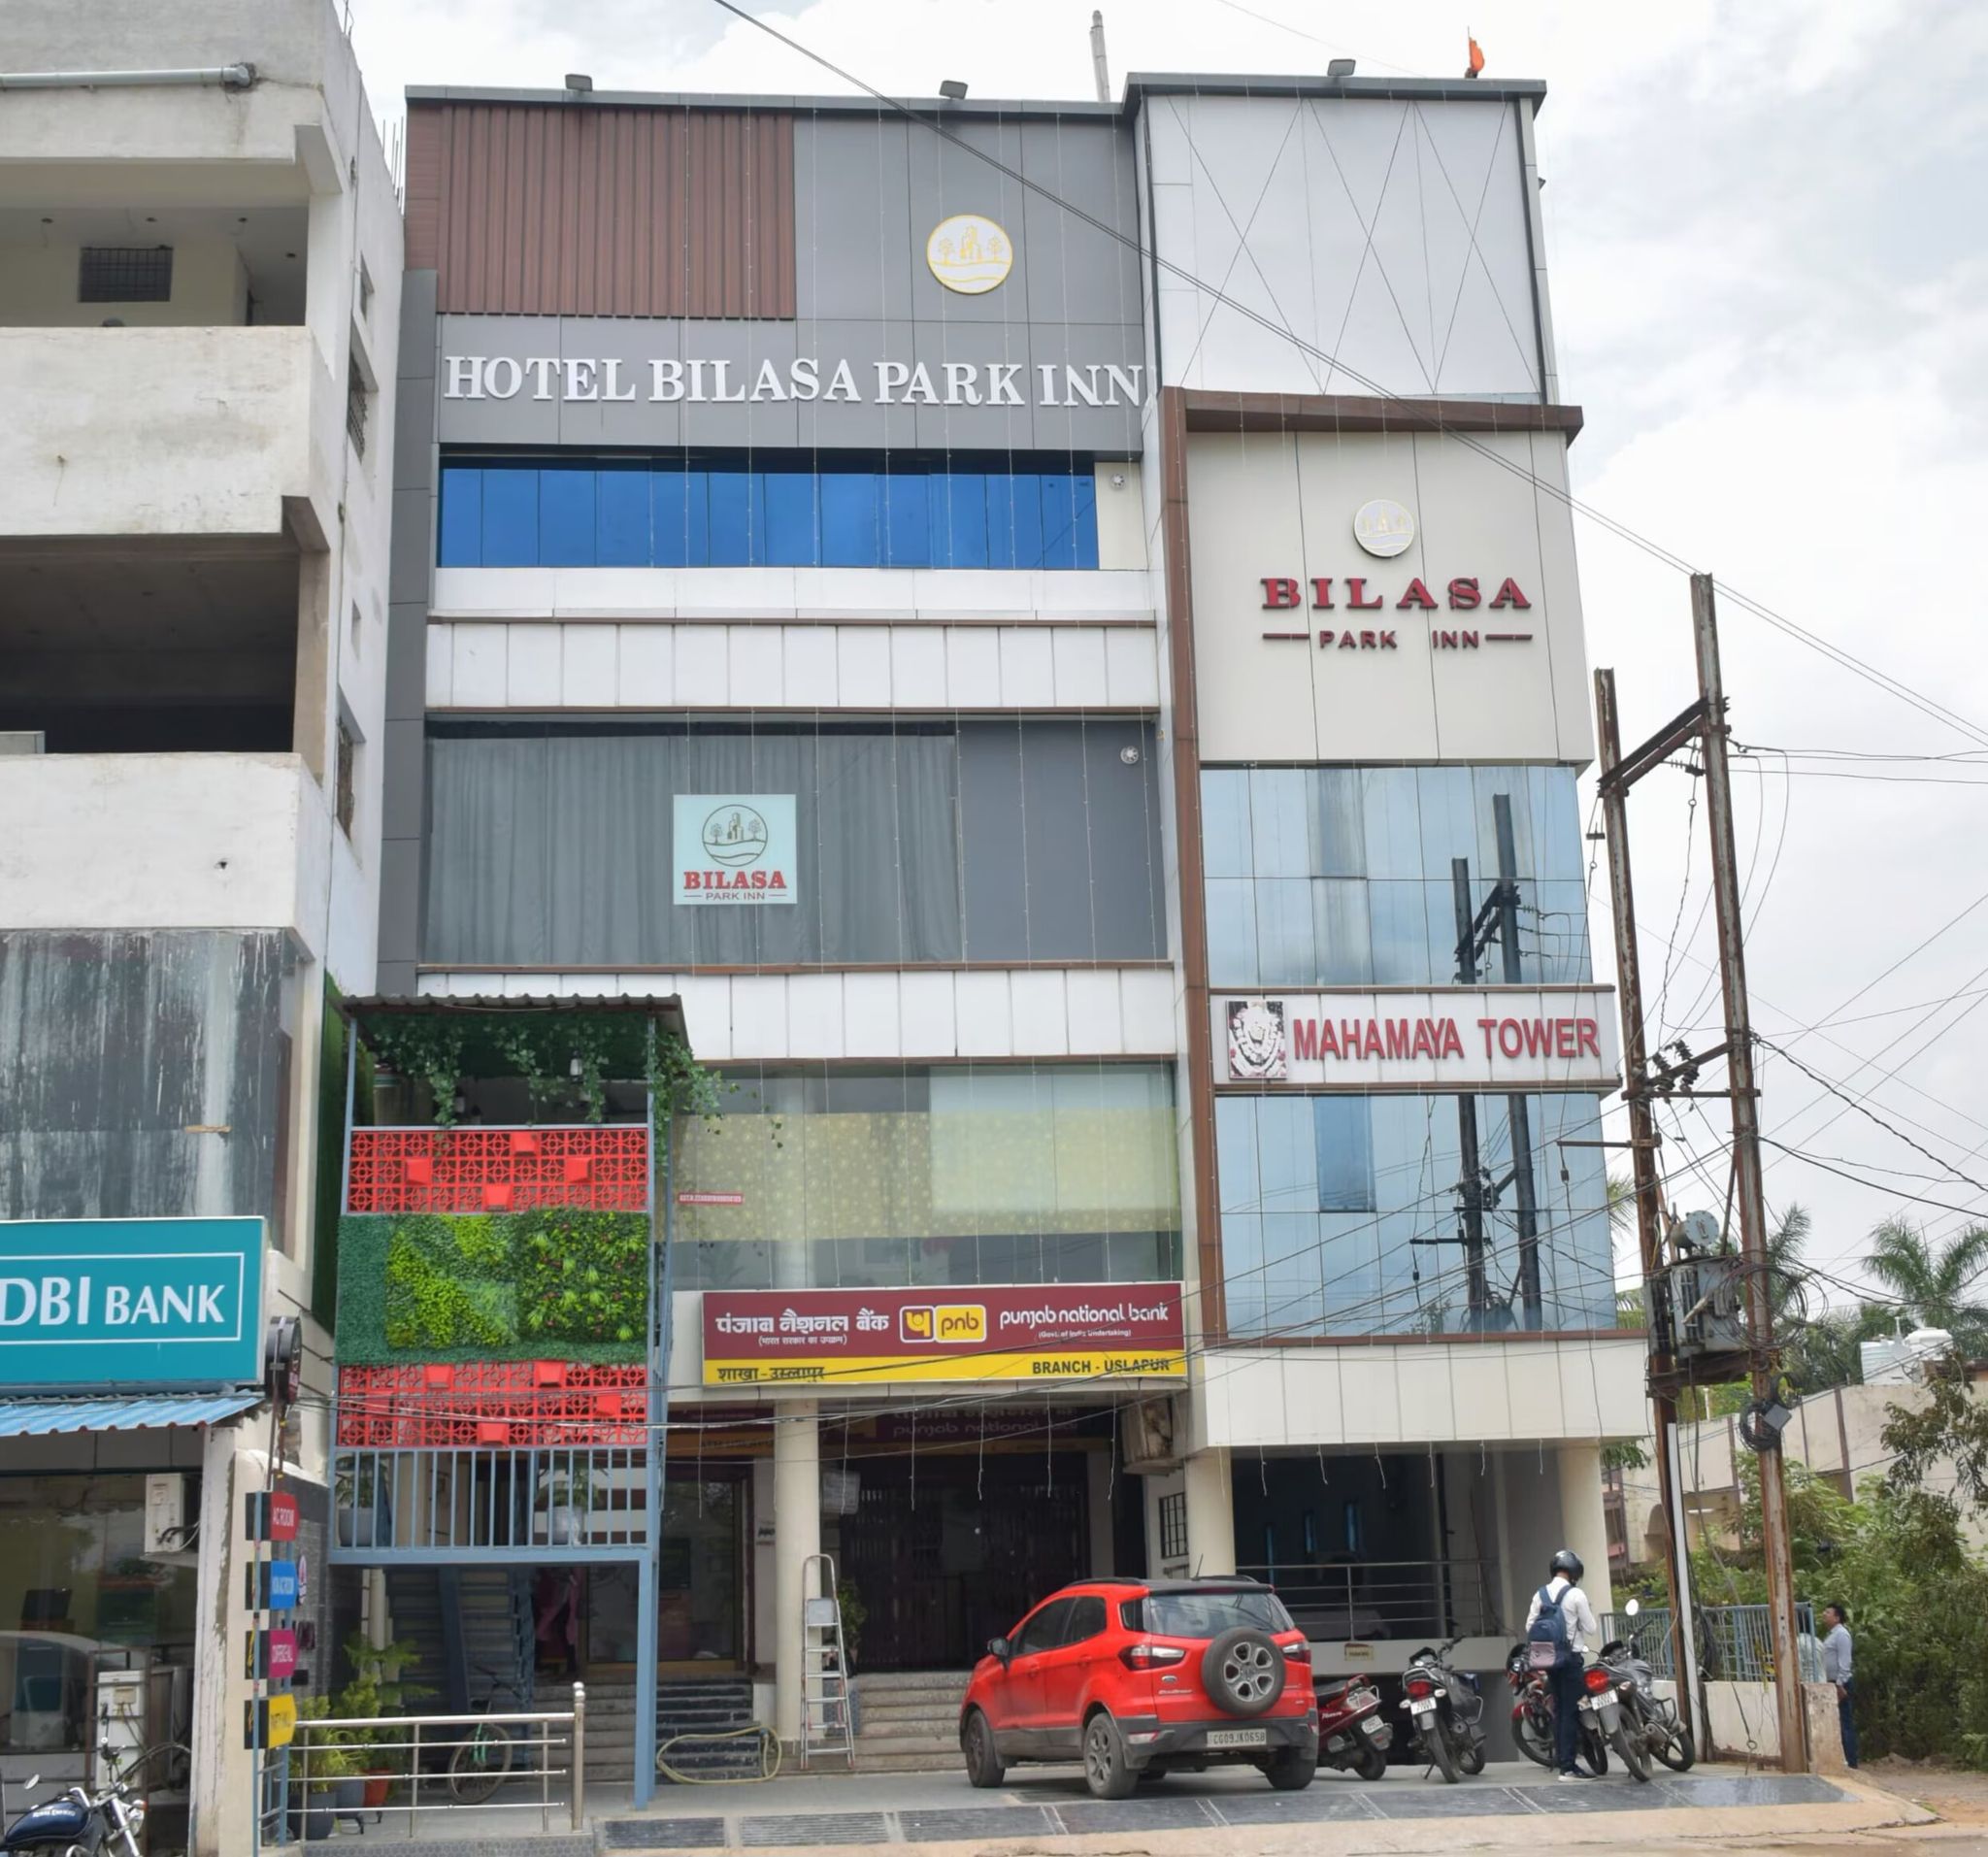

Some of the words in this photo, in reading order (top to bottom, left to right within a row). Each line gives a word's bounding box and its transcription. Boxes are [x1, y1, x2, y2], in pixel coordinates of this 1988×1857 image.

[444, 356, 636, 402] HOTEL
[647, 357, 862, 404] BILASA
[873, 361, 1025, 406] PARK
[1037, 364, 1143, 407] INN
[1260, 577, 1532, 610] BILASA
[1319, 630, 1397, 648] PARK
[1432, 630, 1479, 648] INN
[683, 870, 787, 889] BILASA
[706, 892, 740, 901] PARK
[744, 892, 765, 901] INN
[1293, 1017, 1464, 1060] MAHAMAYA
[1477, 1016, 1601, 1058] TOWER
[105, 1284, 225, 1325] BANK
[1000, 1305, 1057, 1331] punjab
[1059, 1303, 1126, 1324] national
[1128, 1302, 1169, 1321] bank
[779, 1308, 848, 1334] नैशनल
[941, 1311, 979, 1337] pnb
[1032, 1360, 1091, 1375] BRANCH
[1105, 1358, 1170, 1373] USLAPUR
